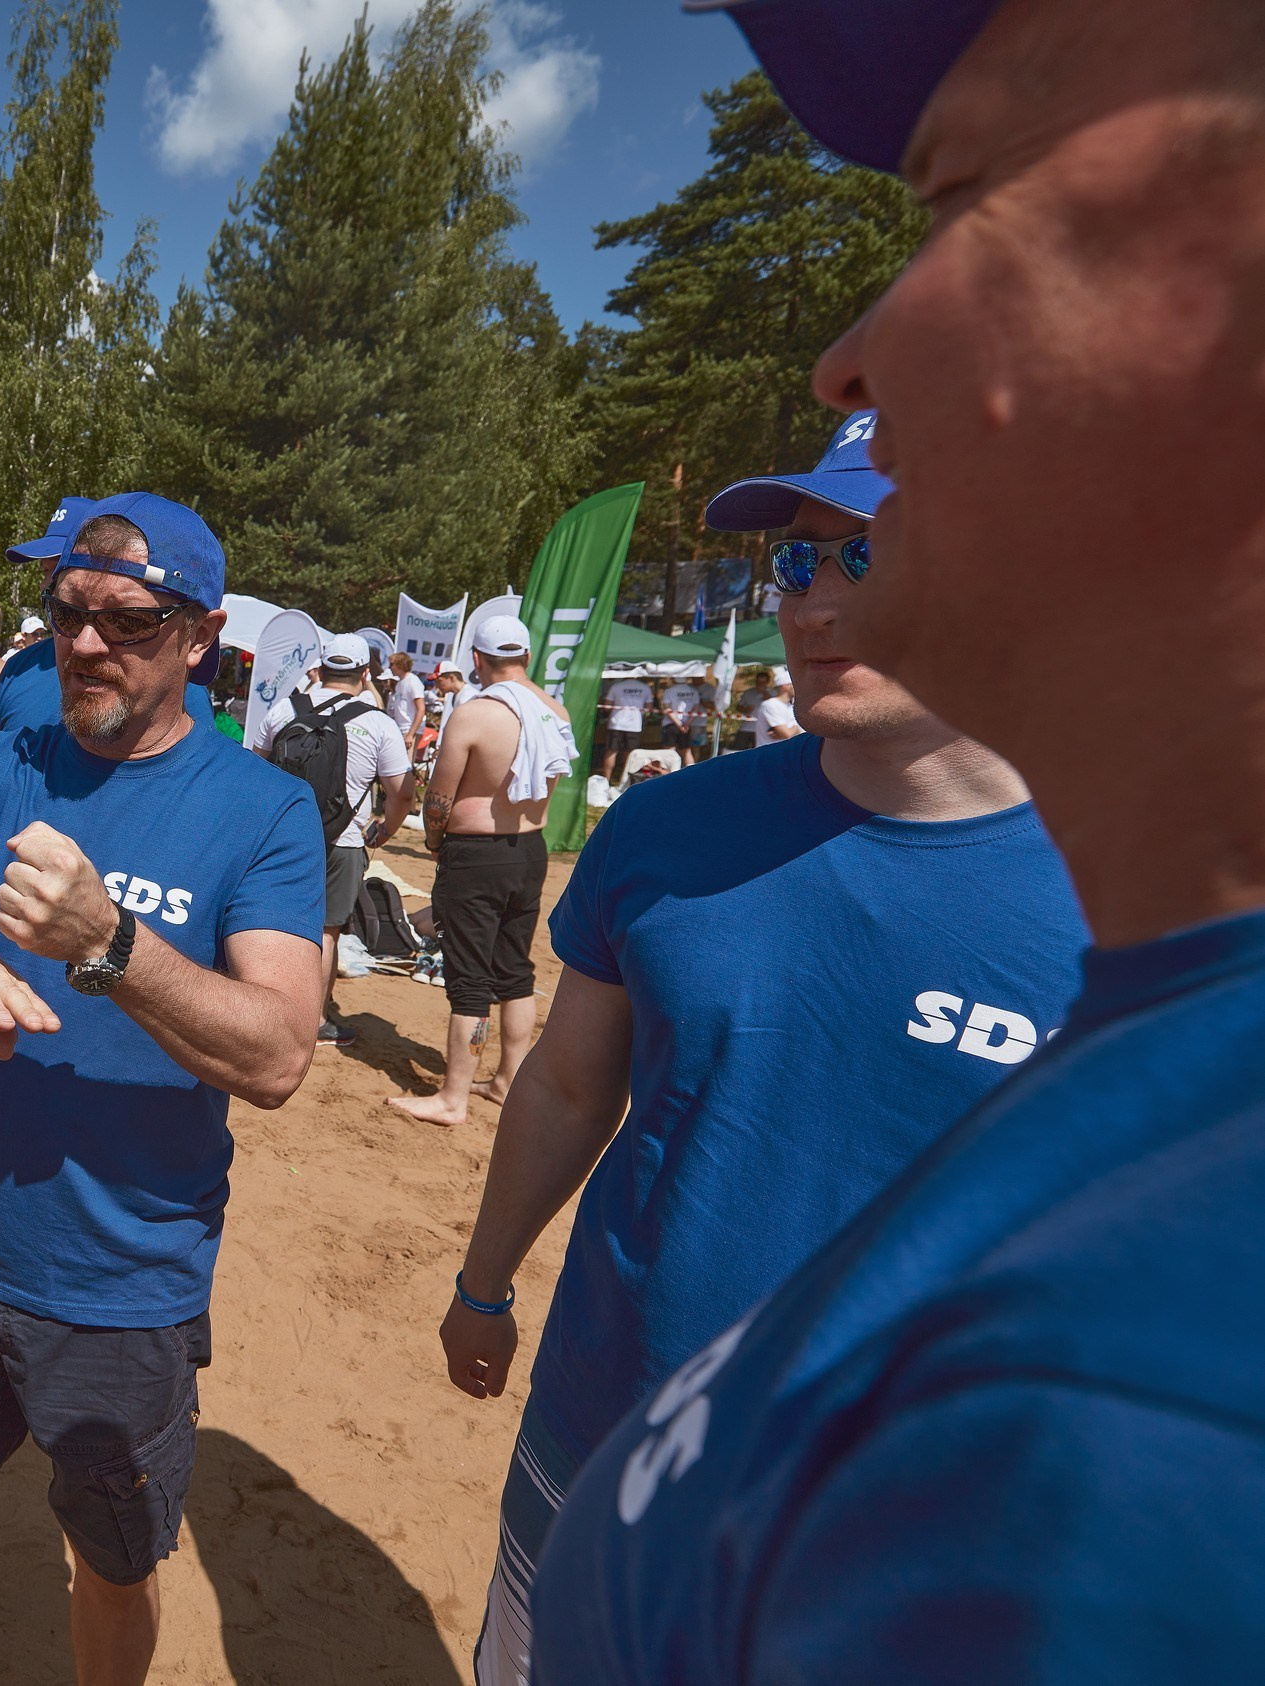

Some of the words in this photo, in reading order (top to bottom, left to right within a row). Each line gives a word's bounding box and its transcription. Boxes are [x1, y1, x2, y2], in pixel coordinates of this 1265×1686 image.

[51, 509, 68, 522] DS
[103, 871, 193, 925] SDS
[907, 990, 1064, 1065] SD
